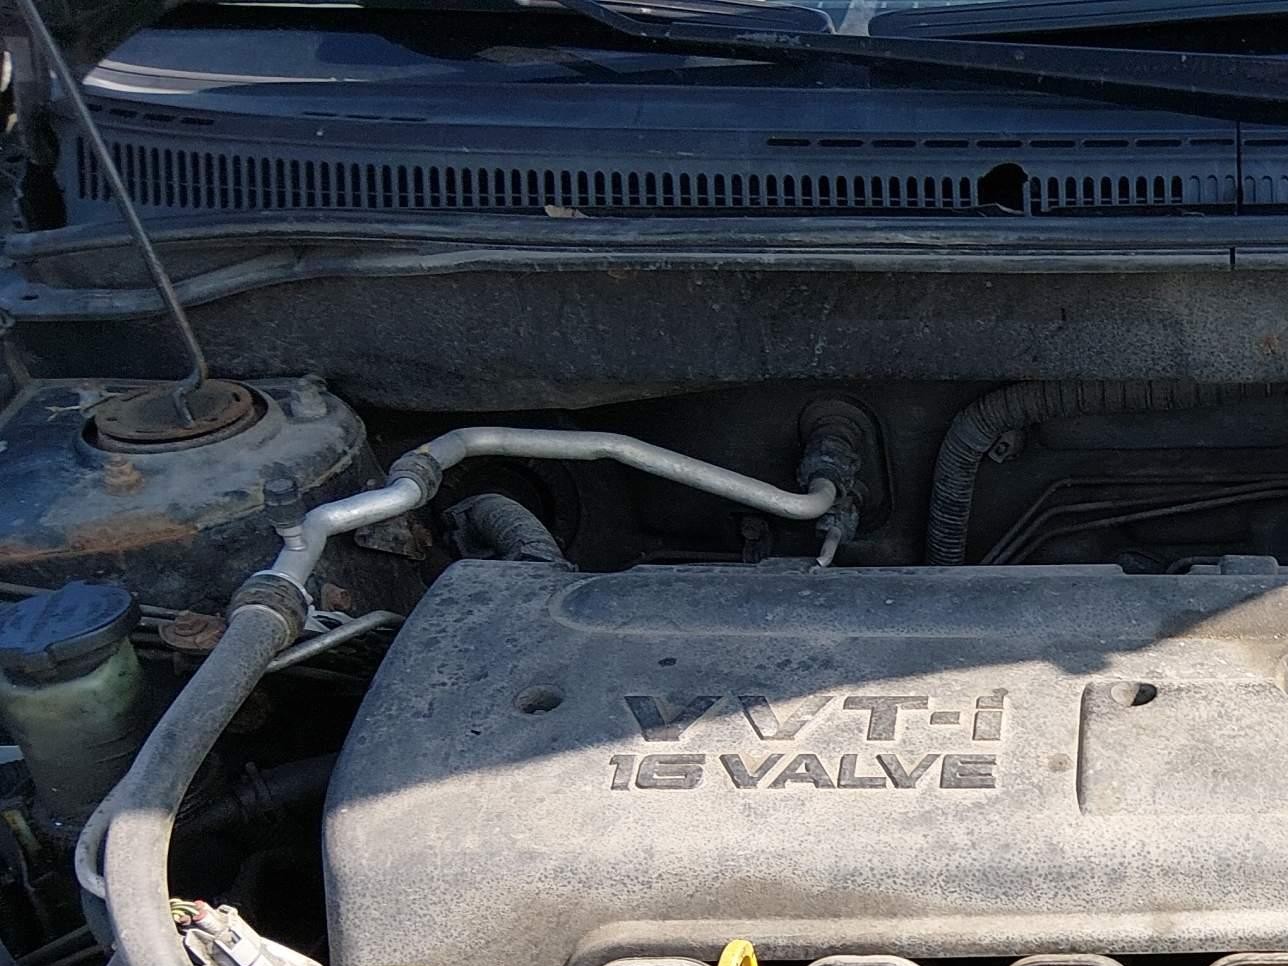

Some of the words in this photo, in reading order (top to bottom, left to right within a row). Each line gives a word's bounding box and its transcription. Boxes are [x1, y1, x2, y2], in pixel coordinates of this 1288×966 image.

[624, 692, 1008, 742] VVT-i
[609, 754, 706, 791] 16
[719, 753, 997, 790] VALVE
